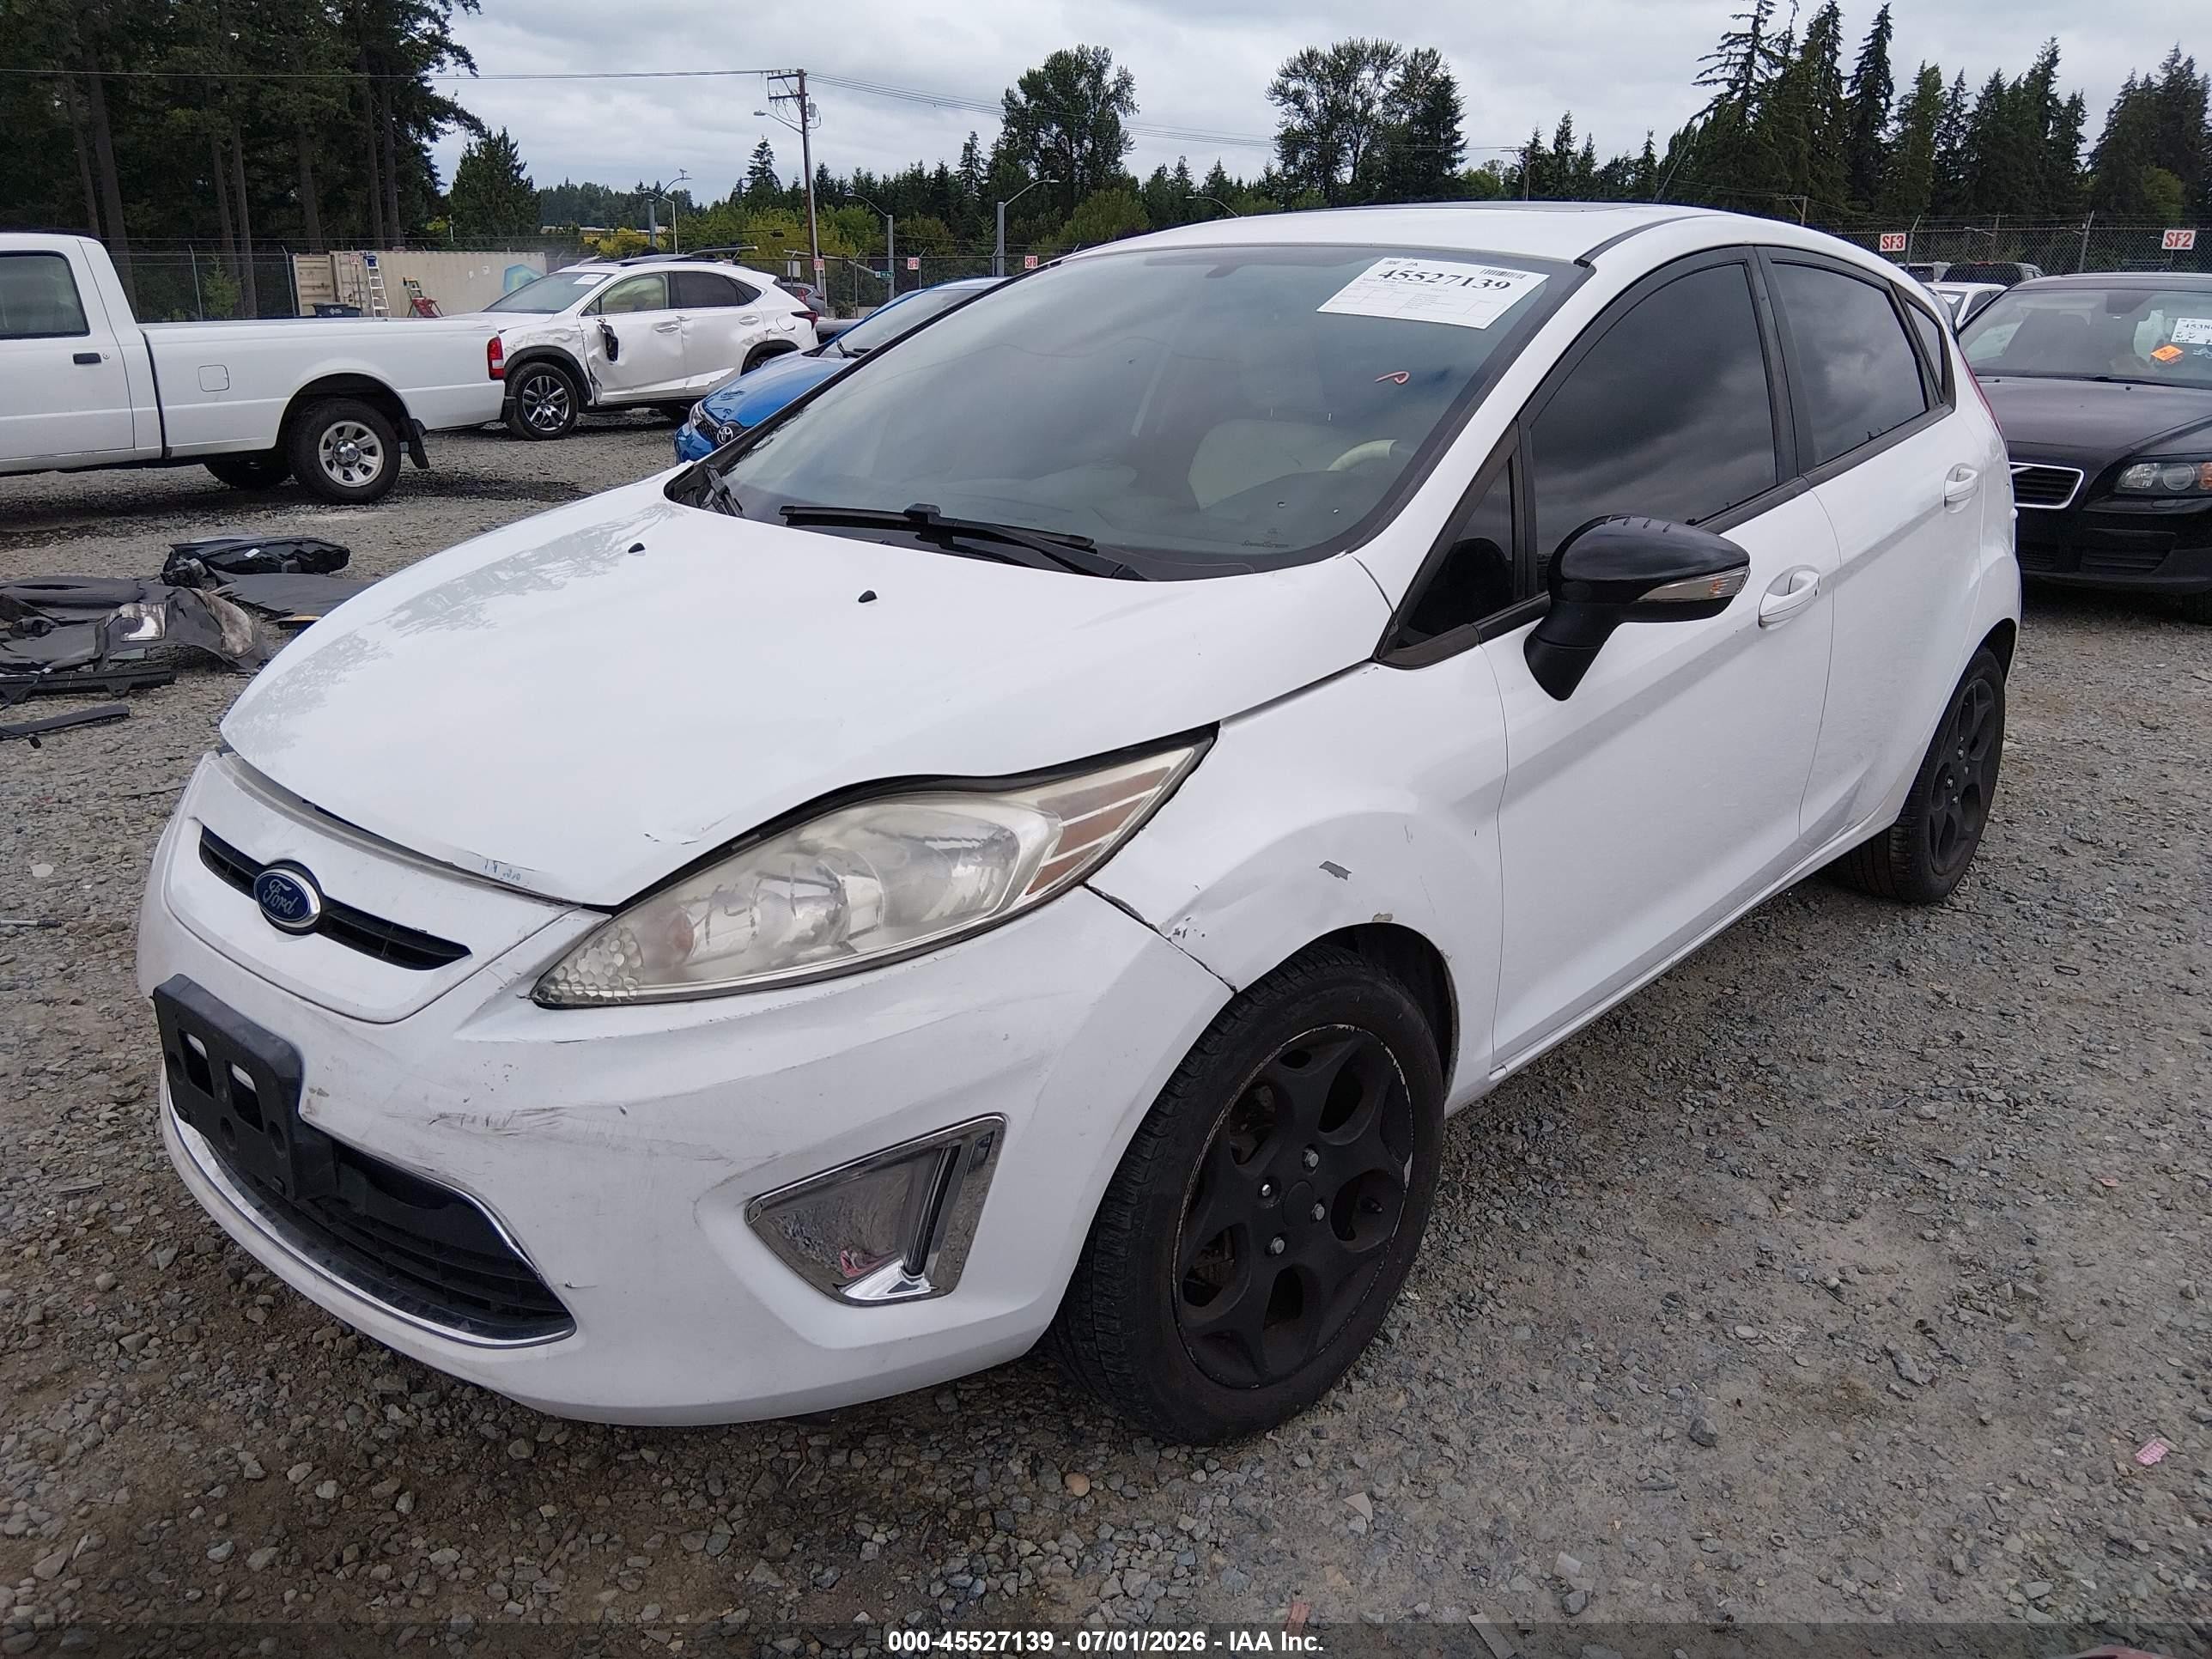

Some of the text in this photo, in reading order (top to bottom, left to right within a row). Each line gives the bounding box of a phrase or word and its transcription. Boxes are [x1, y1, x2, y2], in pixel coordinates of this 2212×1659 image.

[1881, 235, 1905, 249] SF3
[2165, 232, 2192, 248] SF2
[1377, 269, 1511, 291] 45527139
[263, 878, 300, 915] Ford
